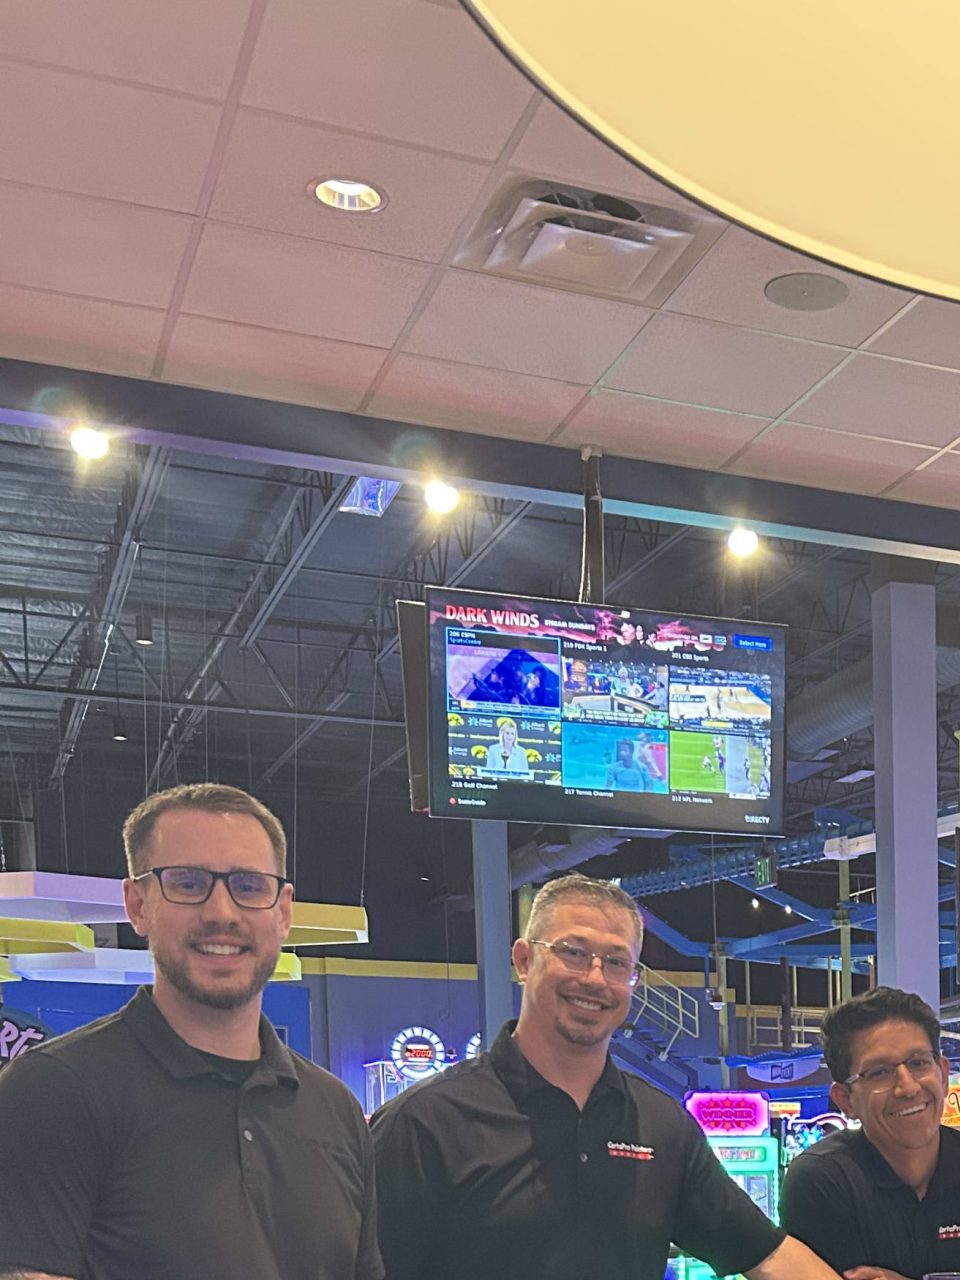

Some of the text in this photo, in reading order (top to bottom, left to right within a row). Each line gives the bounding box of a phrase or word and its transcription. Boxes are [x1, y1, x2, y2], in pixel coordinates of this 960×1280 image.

[446, 605, 540, 627] DARK WINDS
[461, 631, 476, 639] ESPN
[574, 642, 585, 650] FOX
[586, 644, 602, 652] Sports
[693, 653, 709, 662] Sports
[464, 781, 475, 789] Golf
[476, 782, 498, 790] Channel
[593, 790, 614, 798] Channel
[702, 1109, 753, 1120] WINNER
